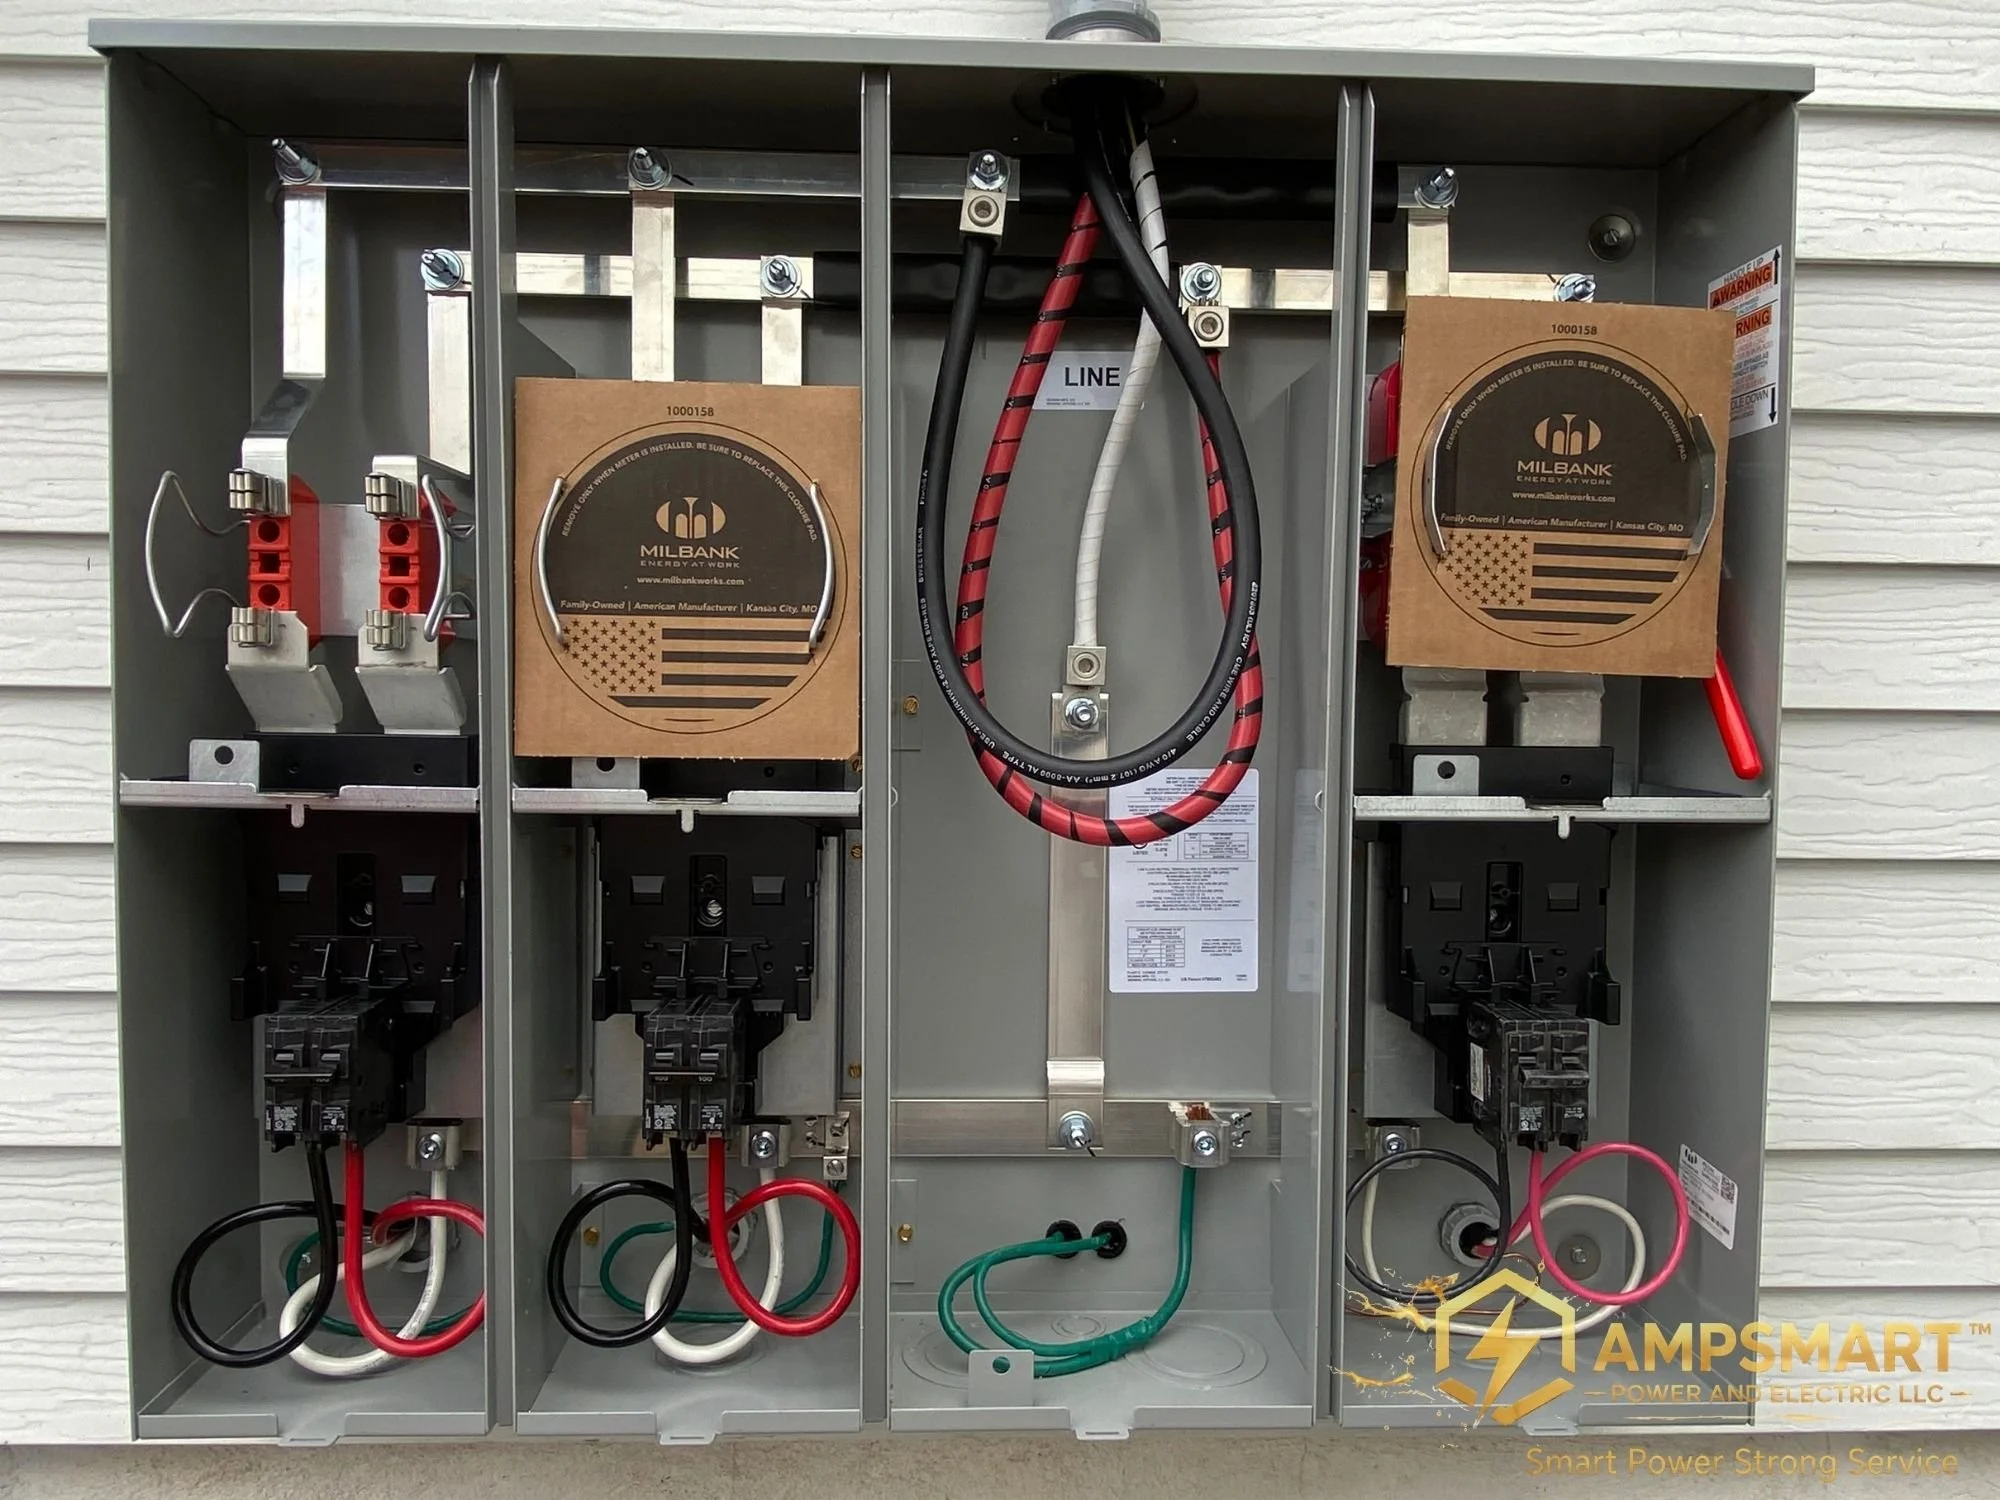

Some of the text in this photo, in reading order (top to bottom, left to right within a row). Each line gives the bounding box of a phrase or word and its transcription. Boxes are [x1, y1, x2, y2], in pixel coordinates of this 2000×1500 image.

[1718, 266, 1771, 301] WARNING
[1551, 324, 1598, 335] 1000158
[1735, 309, 1770, 338] RNING
[1065, 366, 1120, 387] LINE
[1461, 399, 1477, 419] ONLY
[1476, 383, 1499, 402] WHEN
[1498, 368, 1523, 385] METER
[1523, 365, 1532, 373] IS
[1578, 360, 1588, 368] BE
[1590, 361, 1609, 374] SURE
[1611, 368, 1622, 378] TO
[1621, 373, 1653, 399] REPLACE
[1650, 395, 1665, 412] THIS
[1661, 410, 1682, 443] CLOSURE
[666, 405, 715, 417] 1000158
[1517, 460, 1613, 477] MILBANK
[578, 484, 595, 504] ONLY
[594, 465, 616, 486] WHEN
[614, 451, 640, 470] METER
[640, 448, 649, 457] IS
[696, 442, 707, 450] BE
[708, 442, 730, 455] SURE
[731, 449, 742, 459] TO
[742, 455, 775, 479] REPLACE
[774, 474, 790, 493] THIS
[787, 491, 811, 525] CLOSURE
[1516, 475, 1563, 484] ENERGY
[1582, 478, 1612, 486] WORK
[1512, 491, 1616, 503] www.milbankworks.com
[1440, 512, 1500, 525] Family-Owned
[1507, 516, 1548, 526] American
[1550, 518, 1608, 529] Manufacturer
[1615, 520, 1645, 531] Kansas
[1667, 523, 1684, 533] MO
[640, 544, 740, 560] MILBANK
[640, 560, 689, 568] ENERGY
[637, 575, 745, 586] www.milbankworks.com
[560, 600, 625, 611] Family-Owned
[633, 602, 676, 611] American
[678, 602, 738, 612] Manufacturer
[746, 603, 777, 613] Kansas
[801, 604, 818, 613] MO
[1219, 676, 1237, 700] WIRE
[1208, 697, 1225, 717] AND
[1185, 716, 1211, 742] CABLE
[1002, 750, 1026, 769] TYPE
[1161, 747, 1178, 761] 4/0
